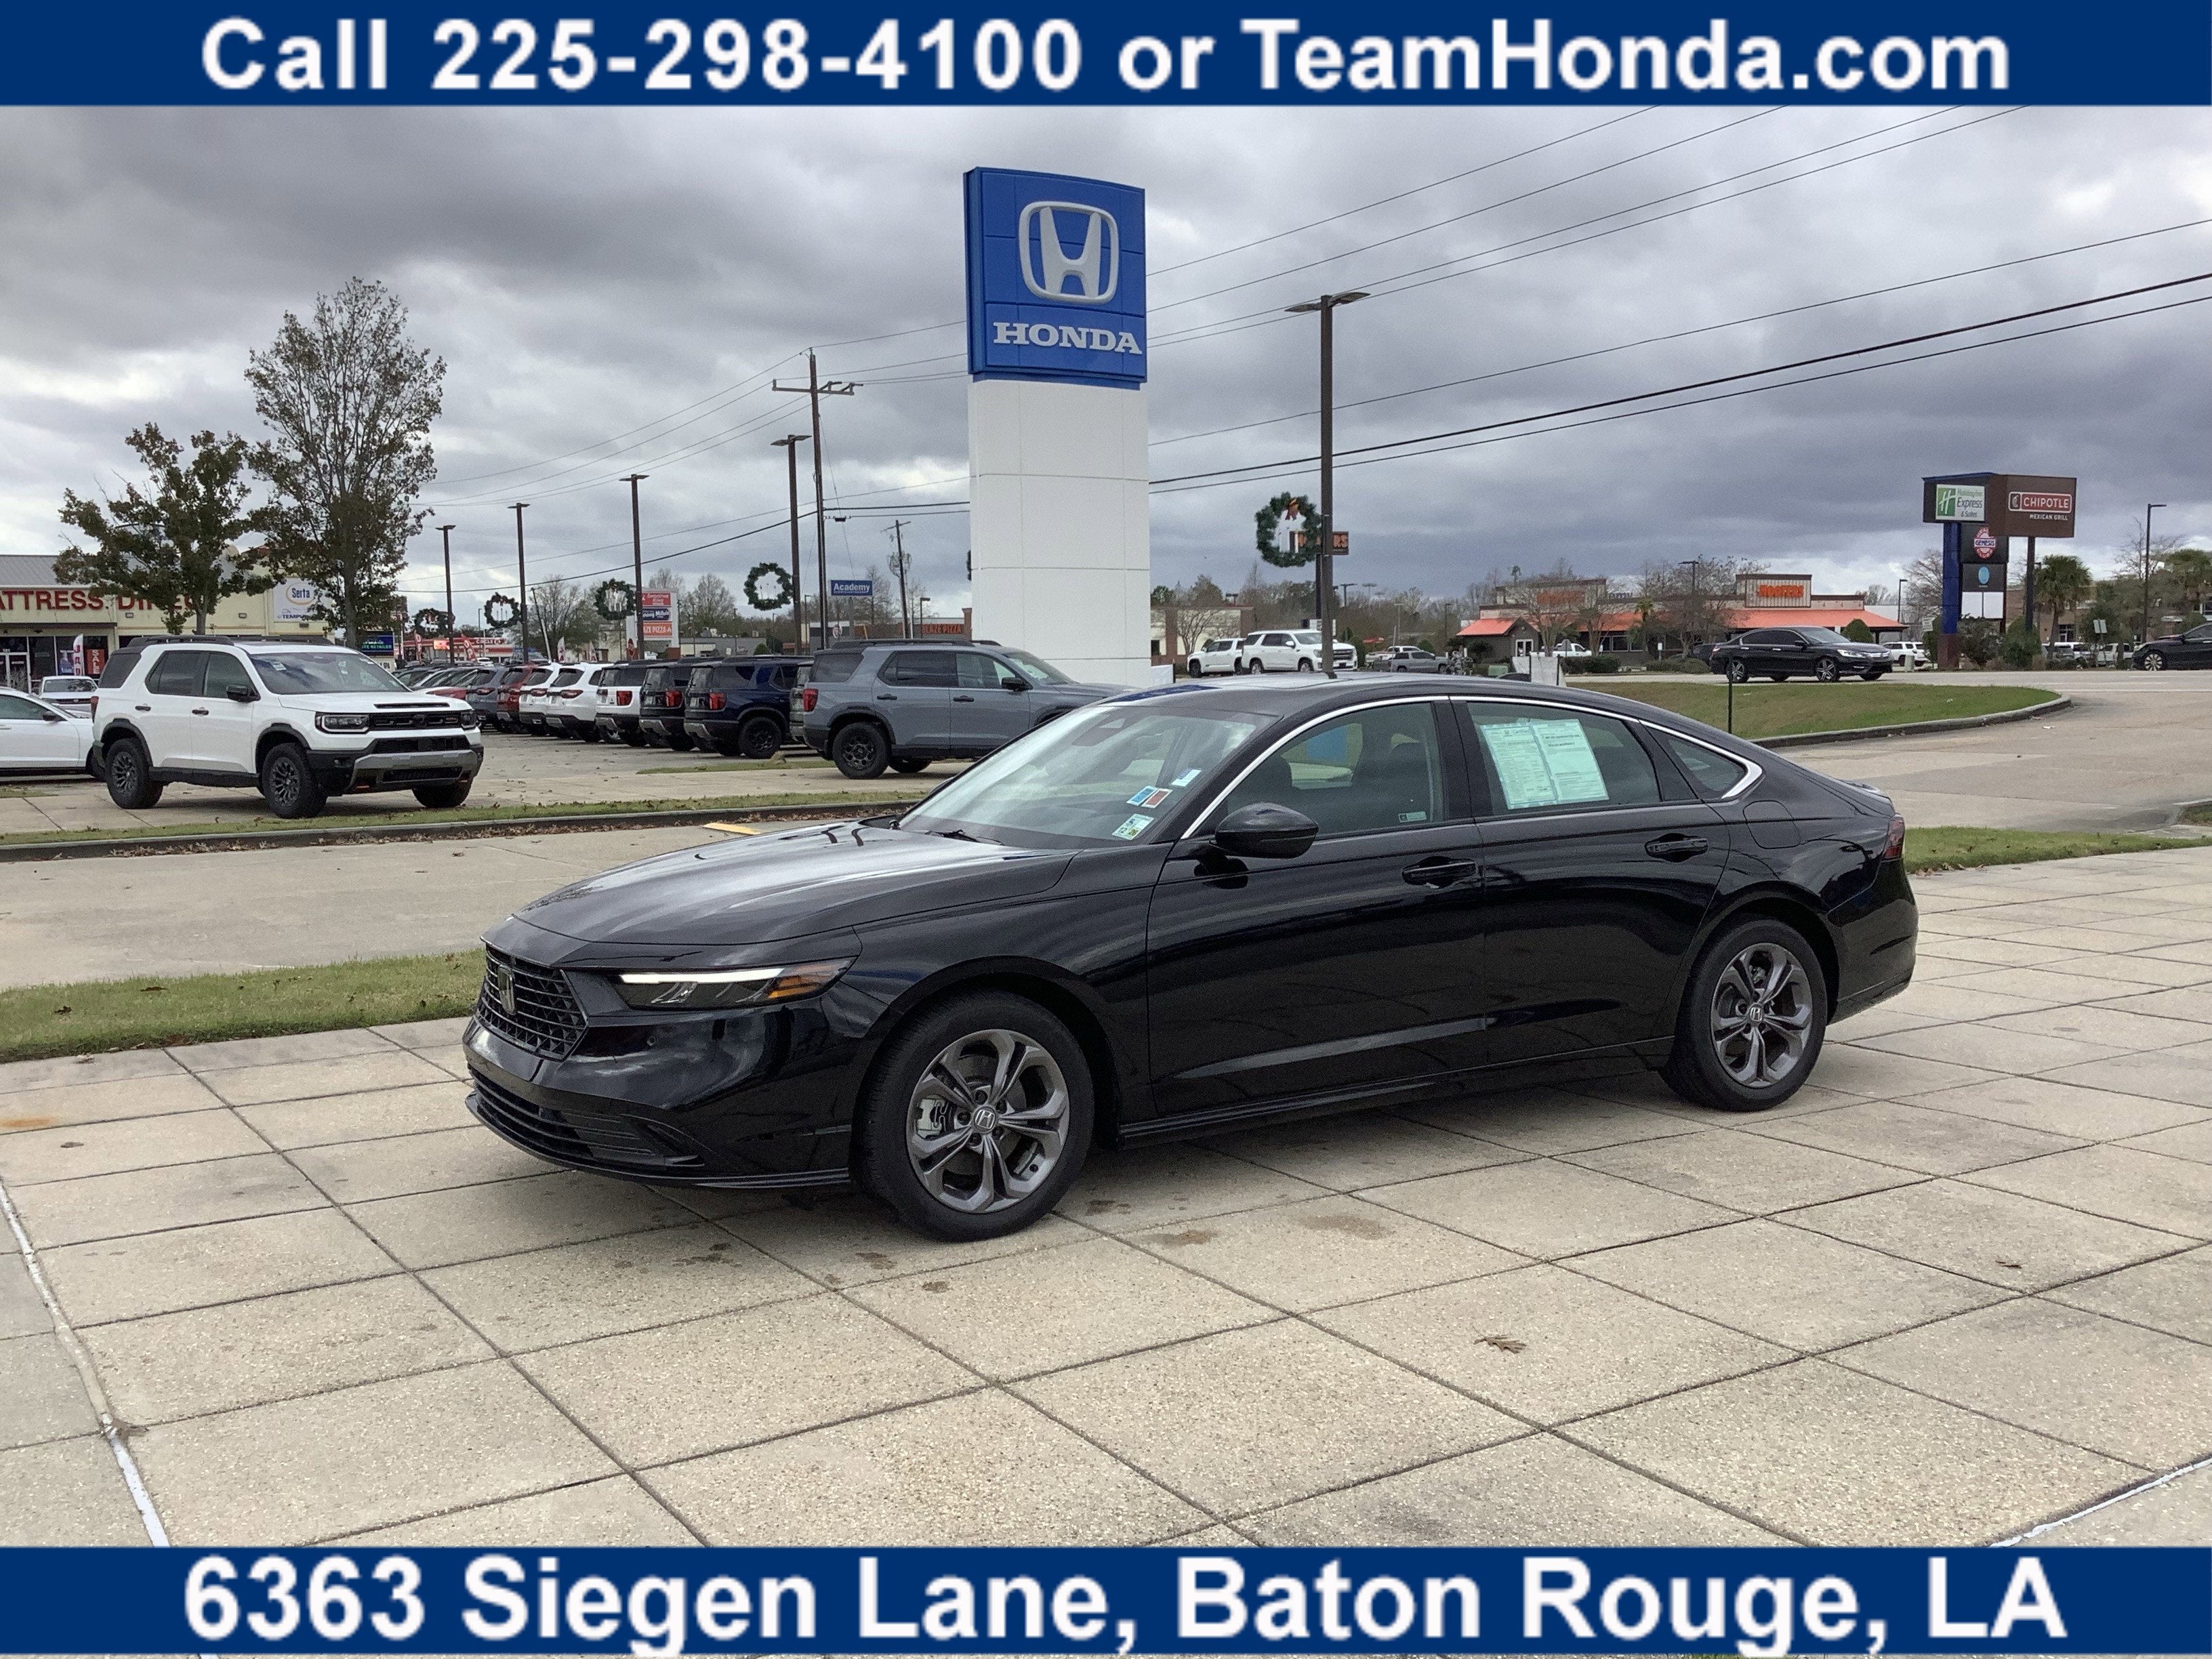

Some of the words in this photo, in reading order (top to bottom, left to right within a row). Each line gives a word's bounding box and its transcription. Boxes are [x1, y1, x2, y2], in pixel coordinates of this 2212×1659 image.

[993, 321, 1143, 355] HONDA
[1957, 497, 1982, 510] Express
[2023, 497, 2069, 508] CHIPOTLE
[292, 588, 310, 598] Serta
[834, 583, 869, 592] Academy
[91, 649, 100, 674] SALE
